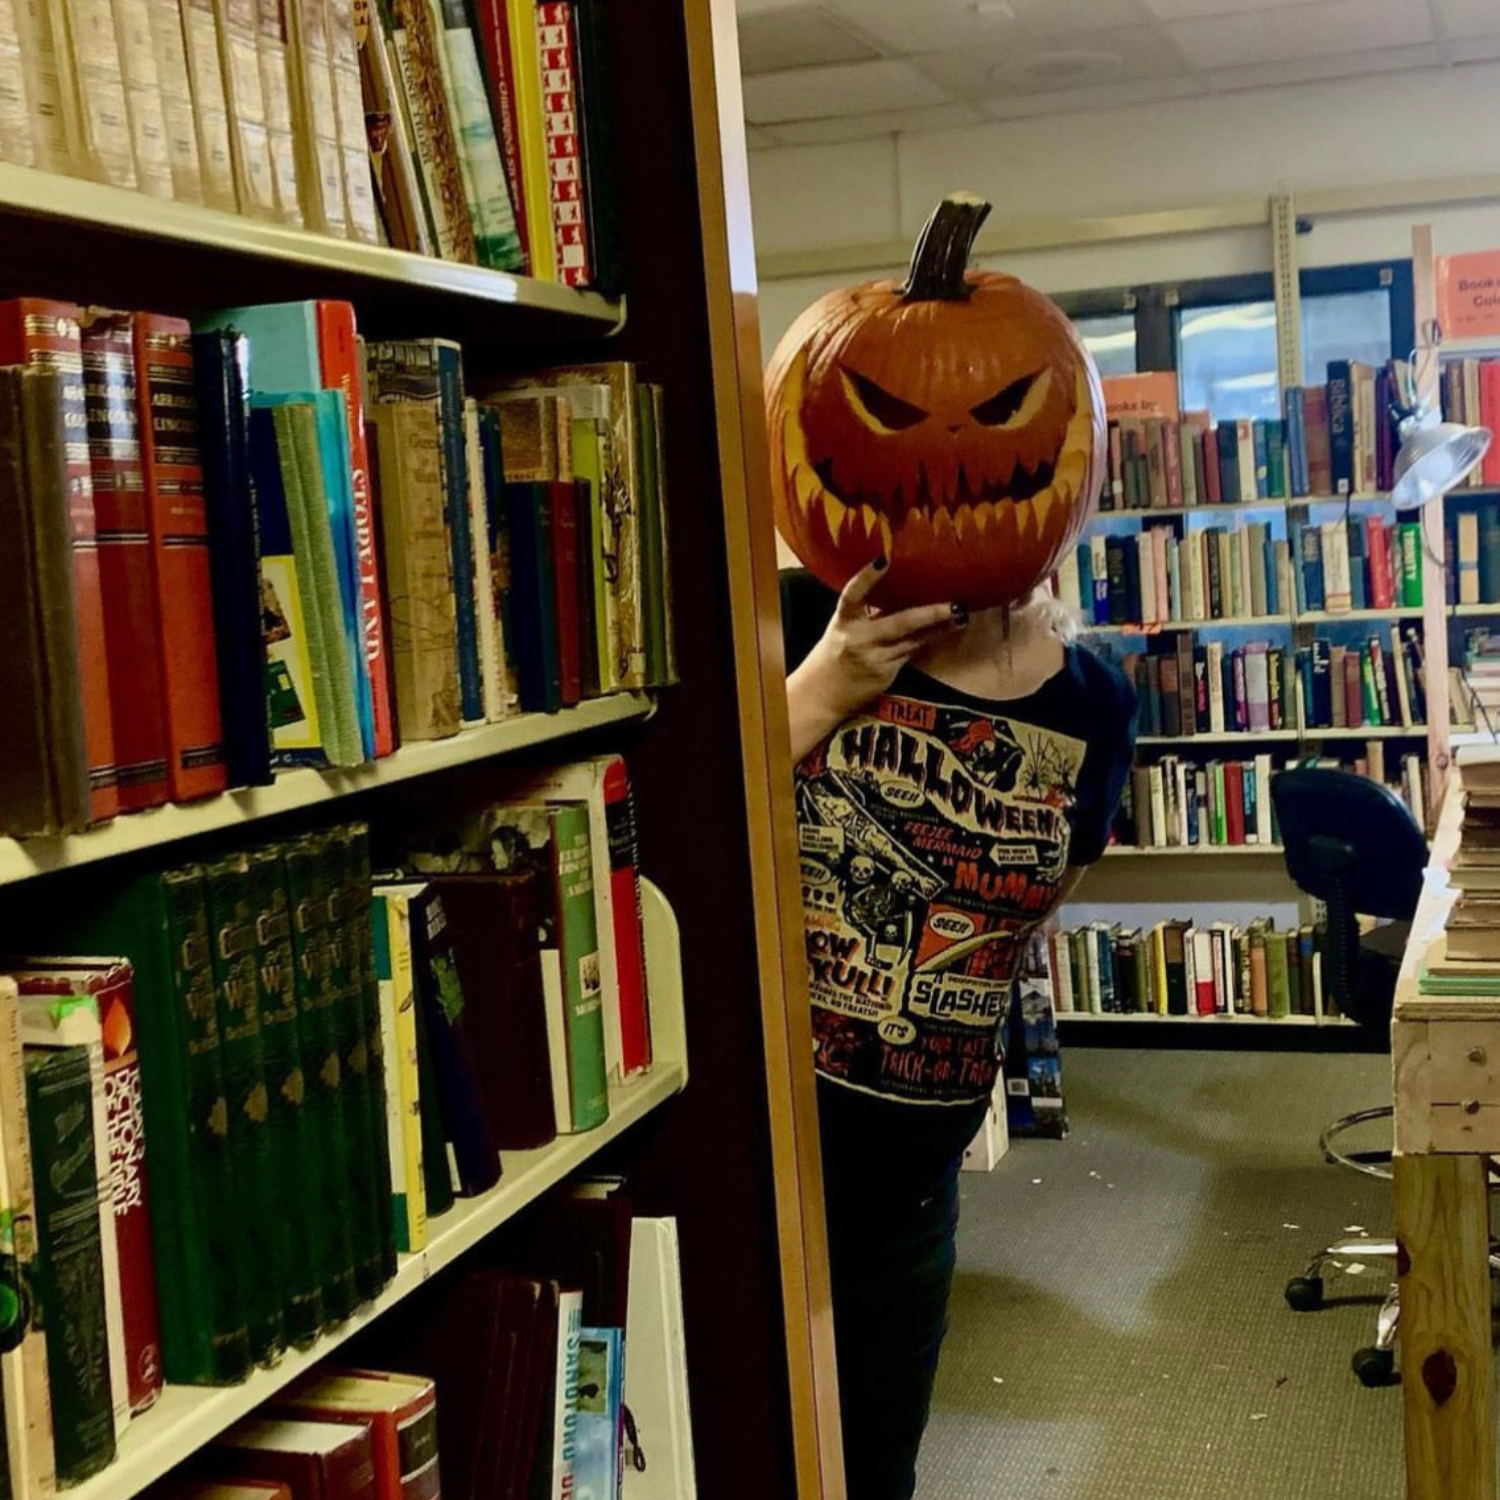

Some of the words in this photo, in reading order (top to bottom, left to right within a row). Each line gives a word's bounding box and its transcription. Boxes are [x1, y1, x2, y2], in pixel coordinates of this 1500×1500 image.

[1402, 529, 1416, 582] TRINITY
[912, 835, 983, 860] MERMAID
[913, 980, 1007, 1018] SLASHE
[115, 1068, 142, 1208] DICTIONARY
